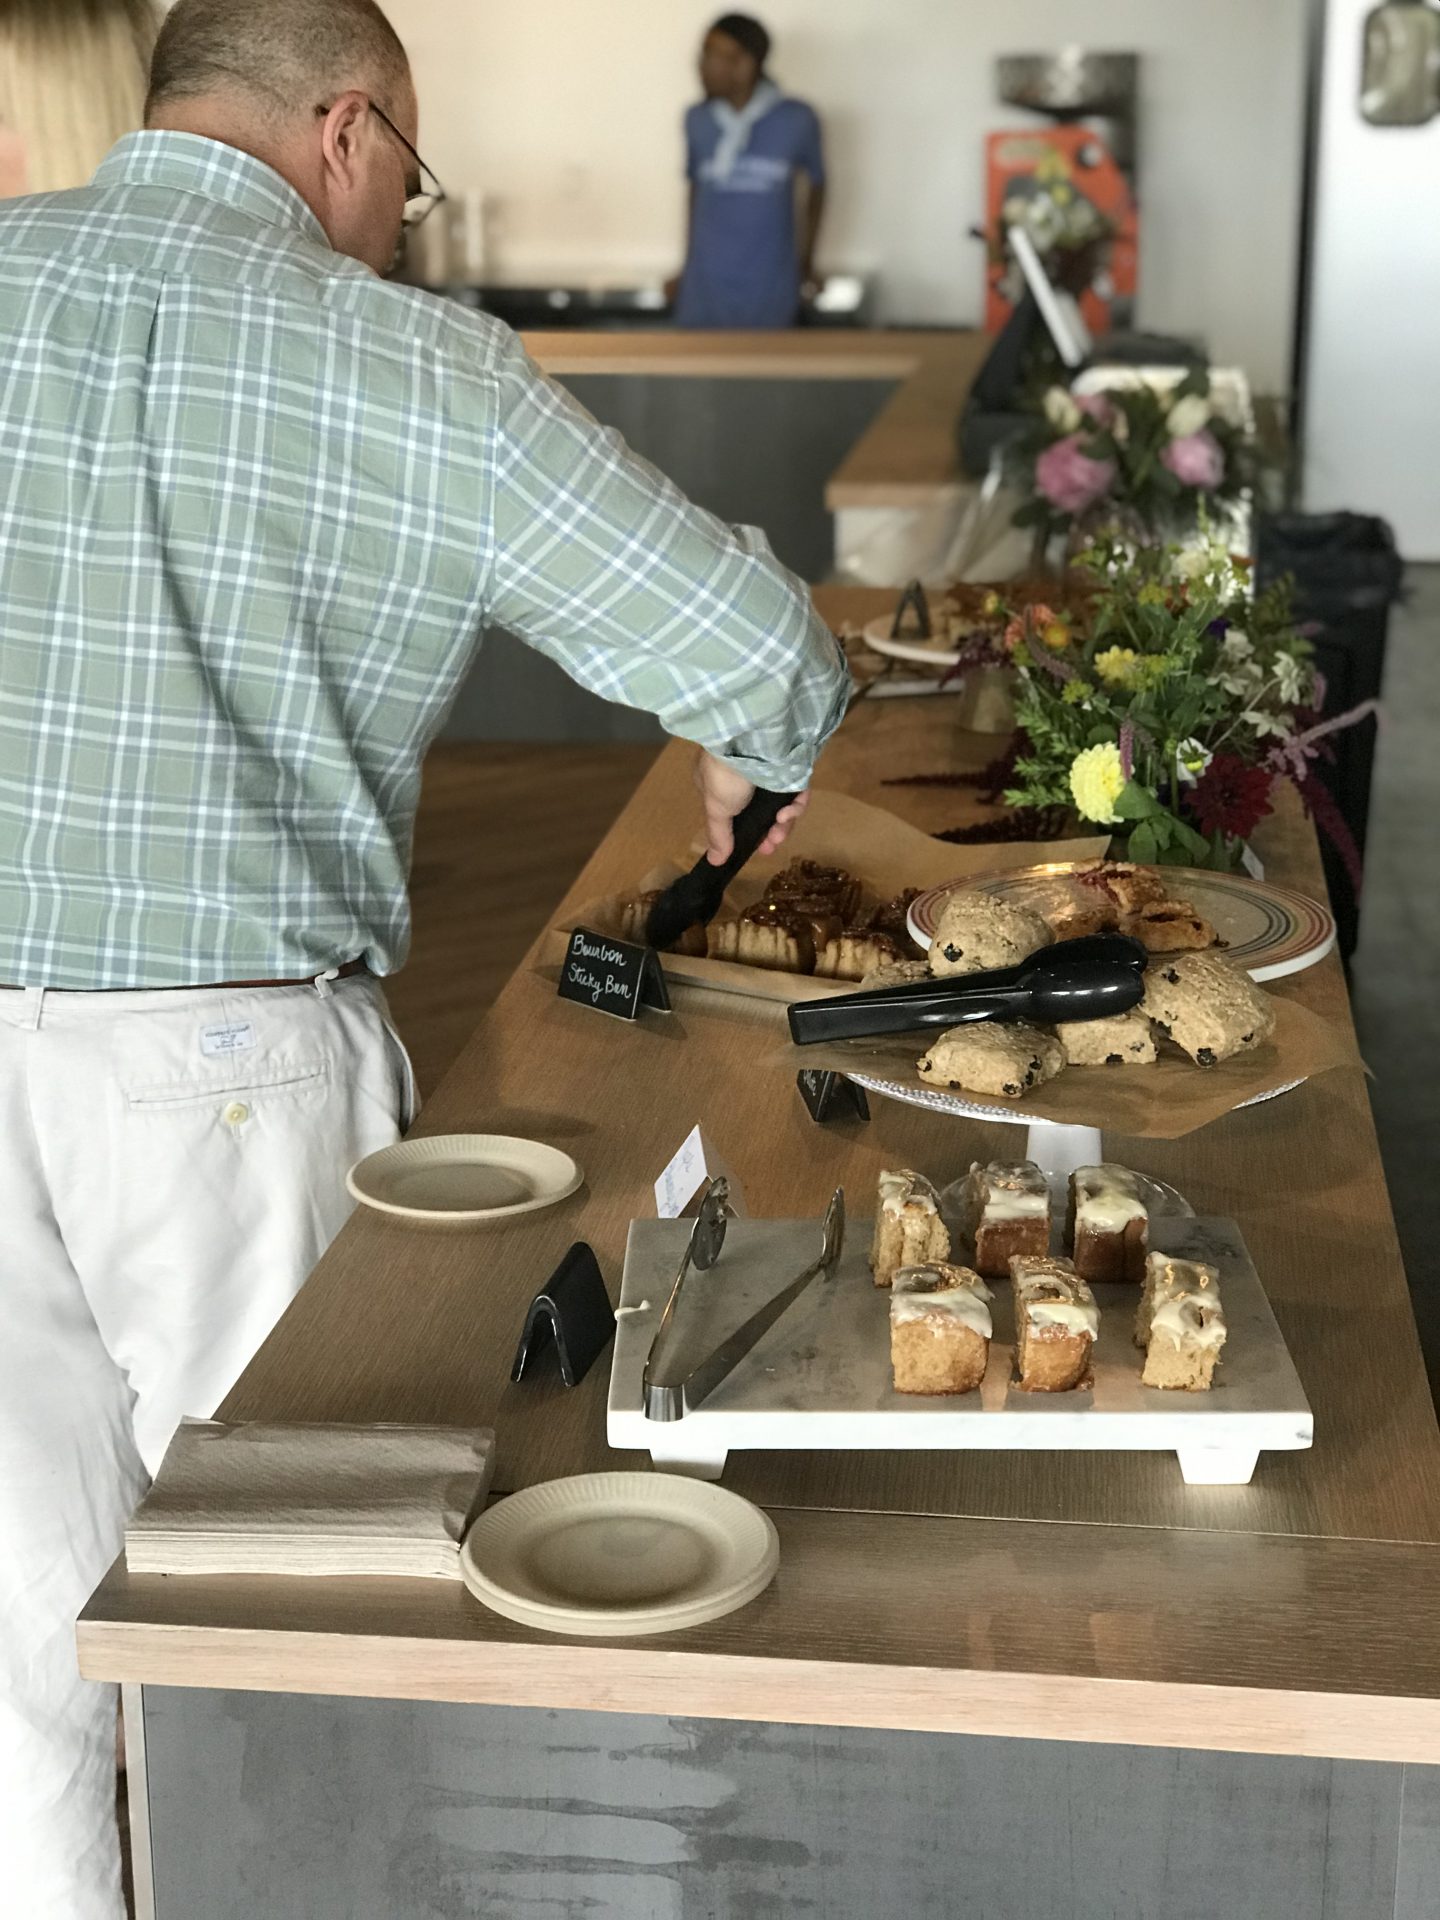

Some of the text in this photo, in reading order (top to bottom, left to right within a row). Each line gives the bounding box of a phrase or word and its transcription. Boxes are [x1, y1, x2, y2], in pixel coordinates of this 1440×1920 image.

[571, 934, 627, 966] Bourbon
[568, 962, 632, 1003] Sticky Bun
